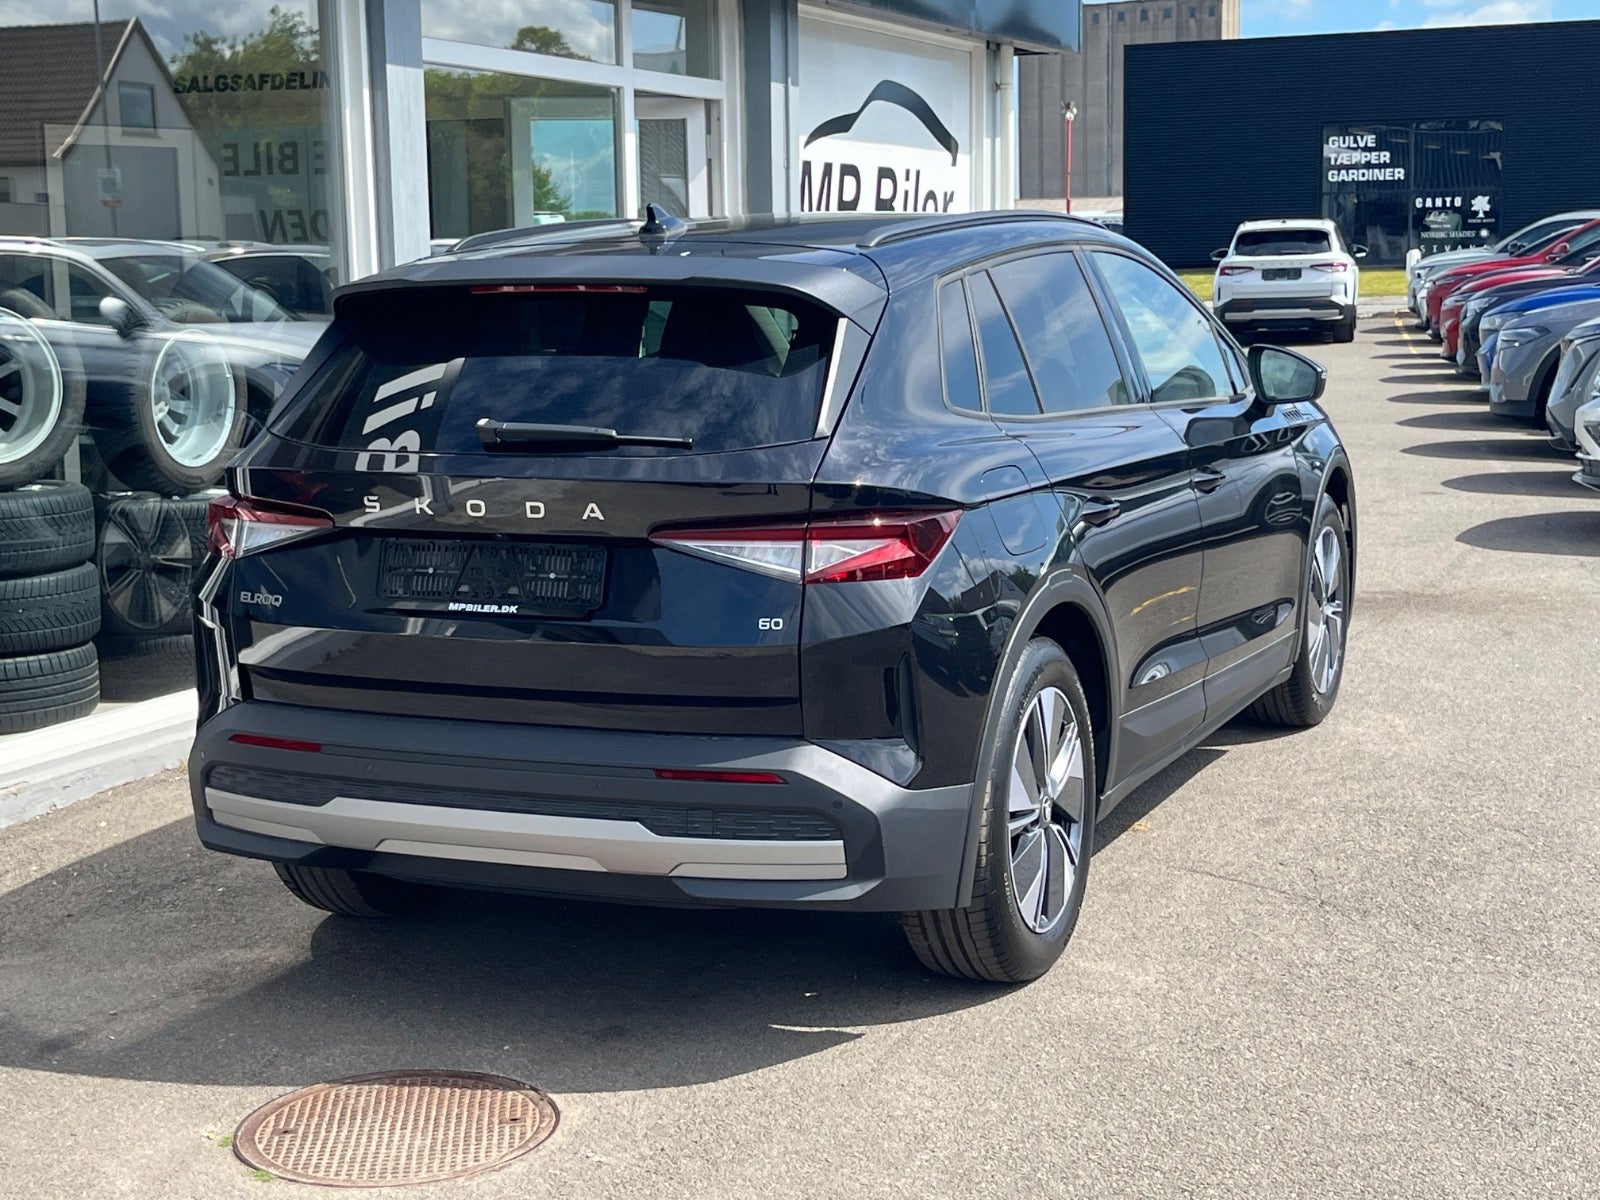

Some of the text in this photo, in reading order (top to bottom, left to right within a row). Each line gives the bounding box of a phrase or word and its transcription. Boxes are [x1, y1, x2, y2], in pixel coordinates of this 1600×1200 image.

[1328, 135, 1377, 148] GULVE
[1328, 151, 1391, 165] TÆPPER
[1327, 168, 1405, 182] GARDINER
[240, 591, 283, 608] ELROQ
[448, 602, 520, 615] MPBILER.DK
[758, 617, 784, 631] 60
